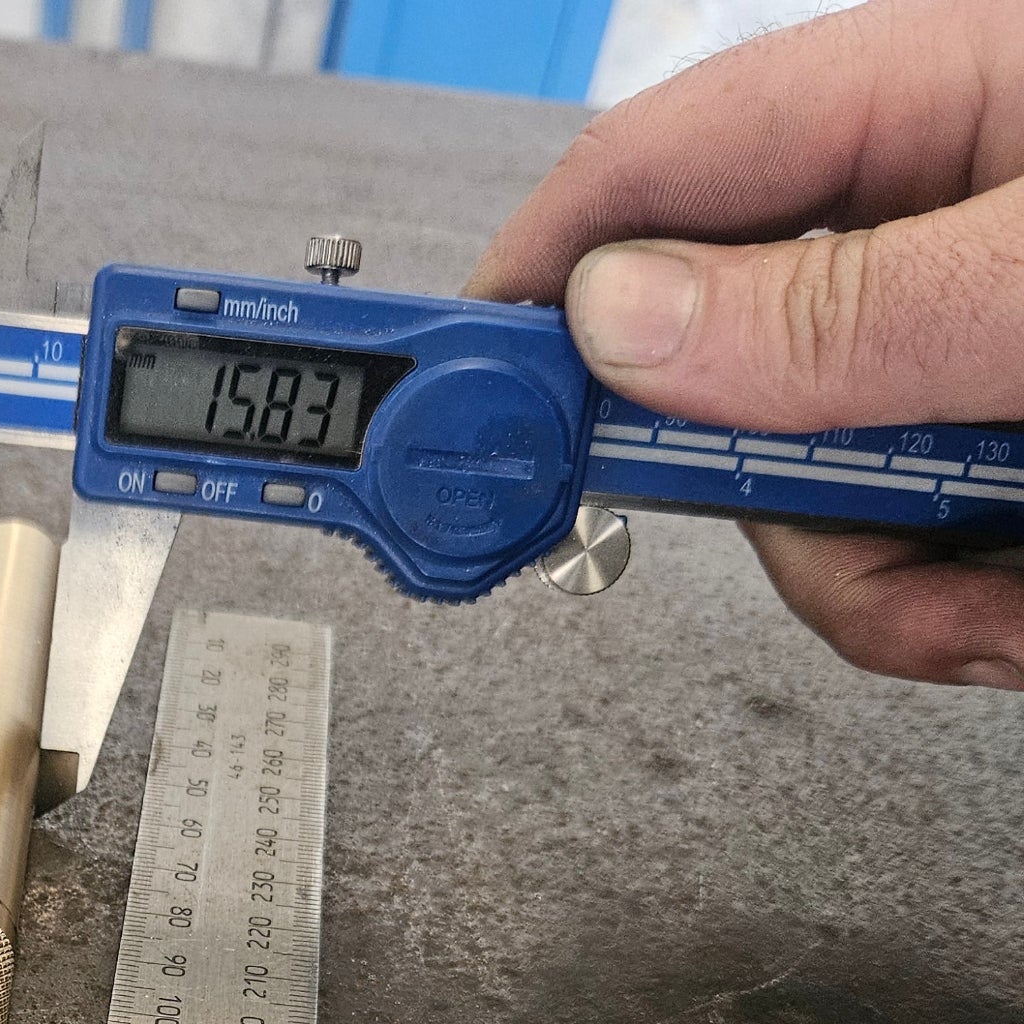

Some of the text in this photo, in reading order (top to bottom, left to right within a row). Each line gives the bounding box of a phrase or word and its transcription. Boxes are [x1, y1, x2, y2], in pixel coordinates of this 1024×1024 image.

[223, 297, 299, 323] mm/inch
[42, 340, 63, 362] 10
[128, 352, 158, 369] mm
[205, 364, 340, 448] 15.83
[899, 431, 934, 455] 120
[975, 440, 1010, 463] 130
[118, 473, 322, 513] ON OFF 0
[435, 485, 496, 511] OPEN
[739, 477, 951, 520] 4 5
[206, 638, 225, 652] 10
[201, 669, 222, 686] 20
[267, 677, 289, 702] 280
[196, 704, 218, 723] 30
[264, 711, 286, 737] 270
[191, 740, 213, 758] 40
[261, 749, 283, 776] 260
[186, 778, 209, 797] 50
[258, 786, 281, 815] 250
[180, 818, 203, 839] 60
[255, 828, 278, 857] 240
[175, 862, 199, 882] 70
[251, 870, 275, 902] 230
[168, 906, 193, 928] 80
[246, 916, 272, 950] 220
[161, 955, 187, 977] 90
[243, 965, 269, 999] 210
